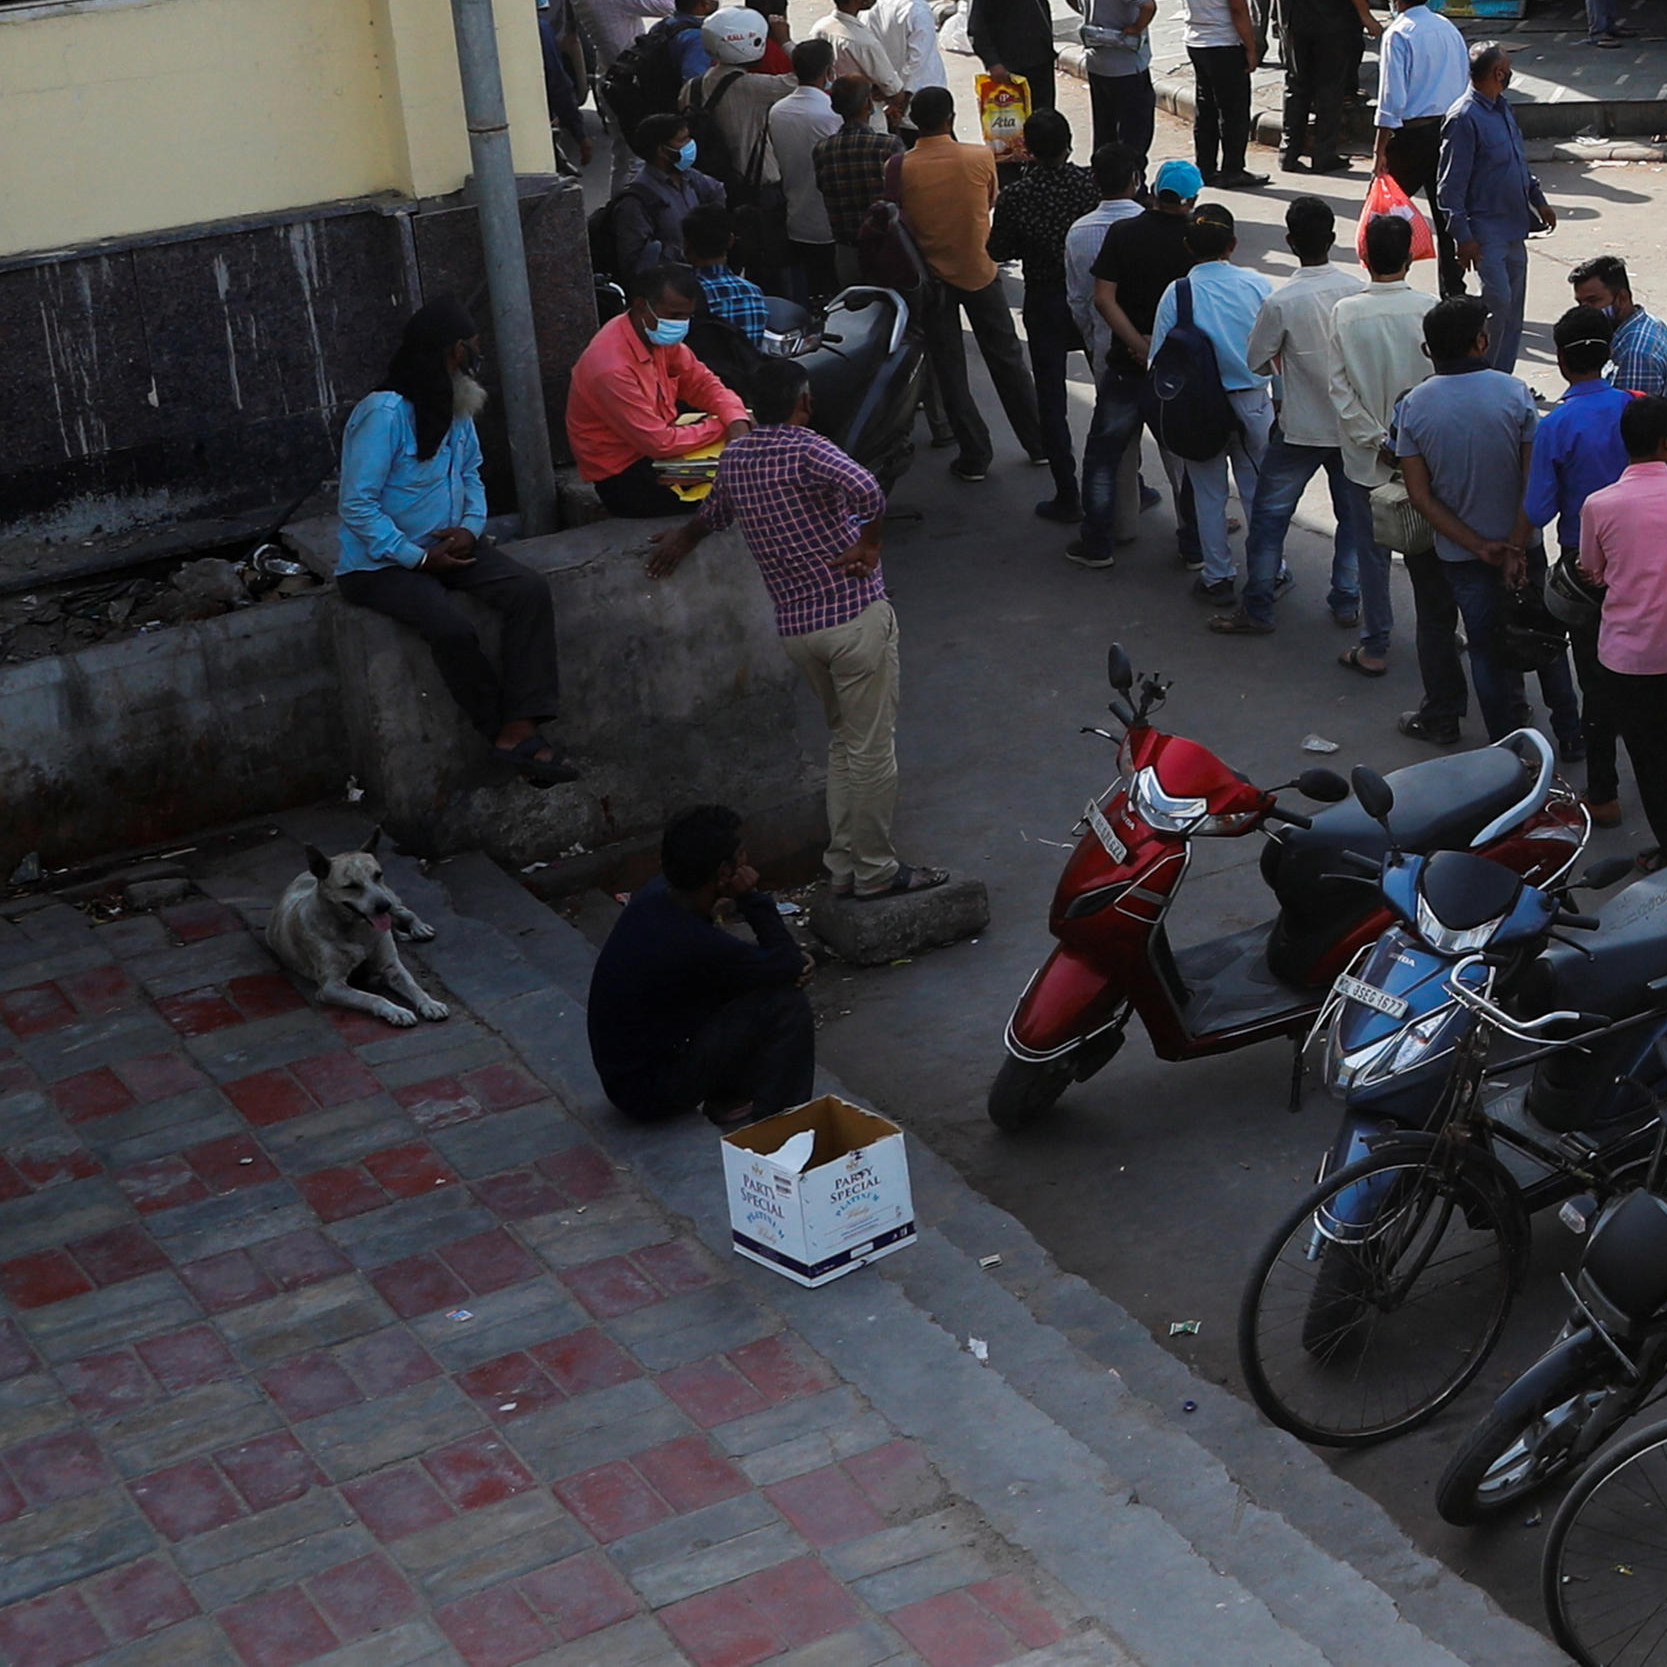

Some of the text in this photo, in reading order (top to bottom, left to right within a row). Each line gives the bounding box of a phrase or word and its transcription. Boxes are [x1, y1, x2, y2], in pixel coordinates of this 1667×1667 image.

[743, 1173, 776, 1201] PARTY
[830, 1176, 881, 1205] SPECIAL
[834, 1165, 873, 1191] PARTY
[740, 1186, 785, 1219] SPECIAL
